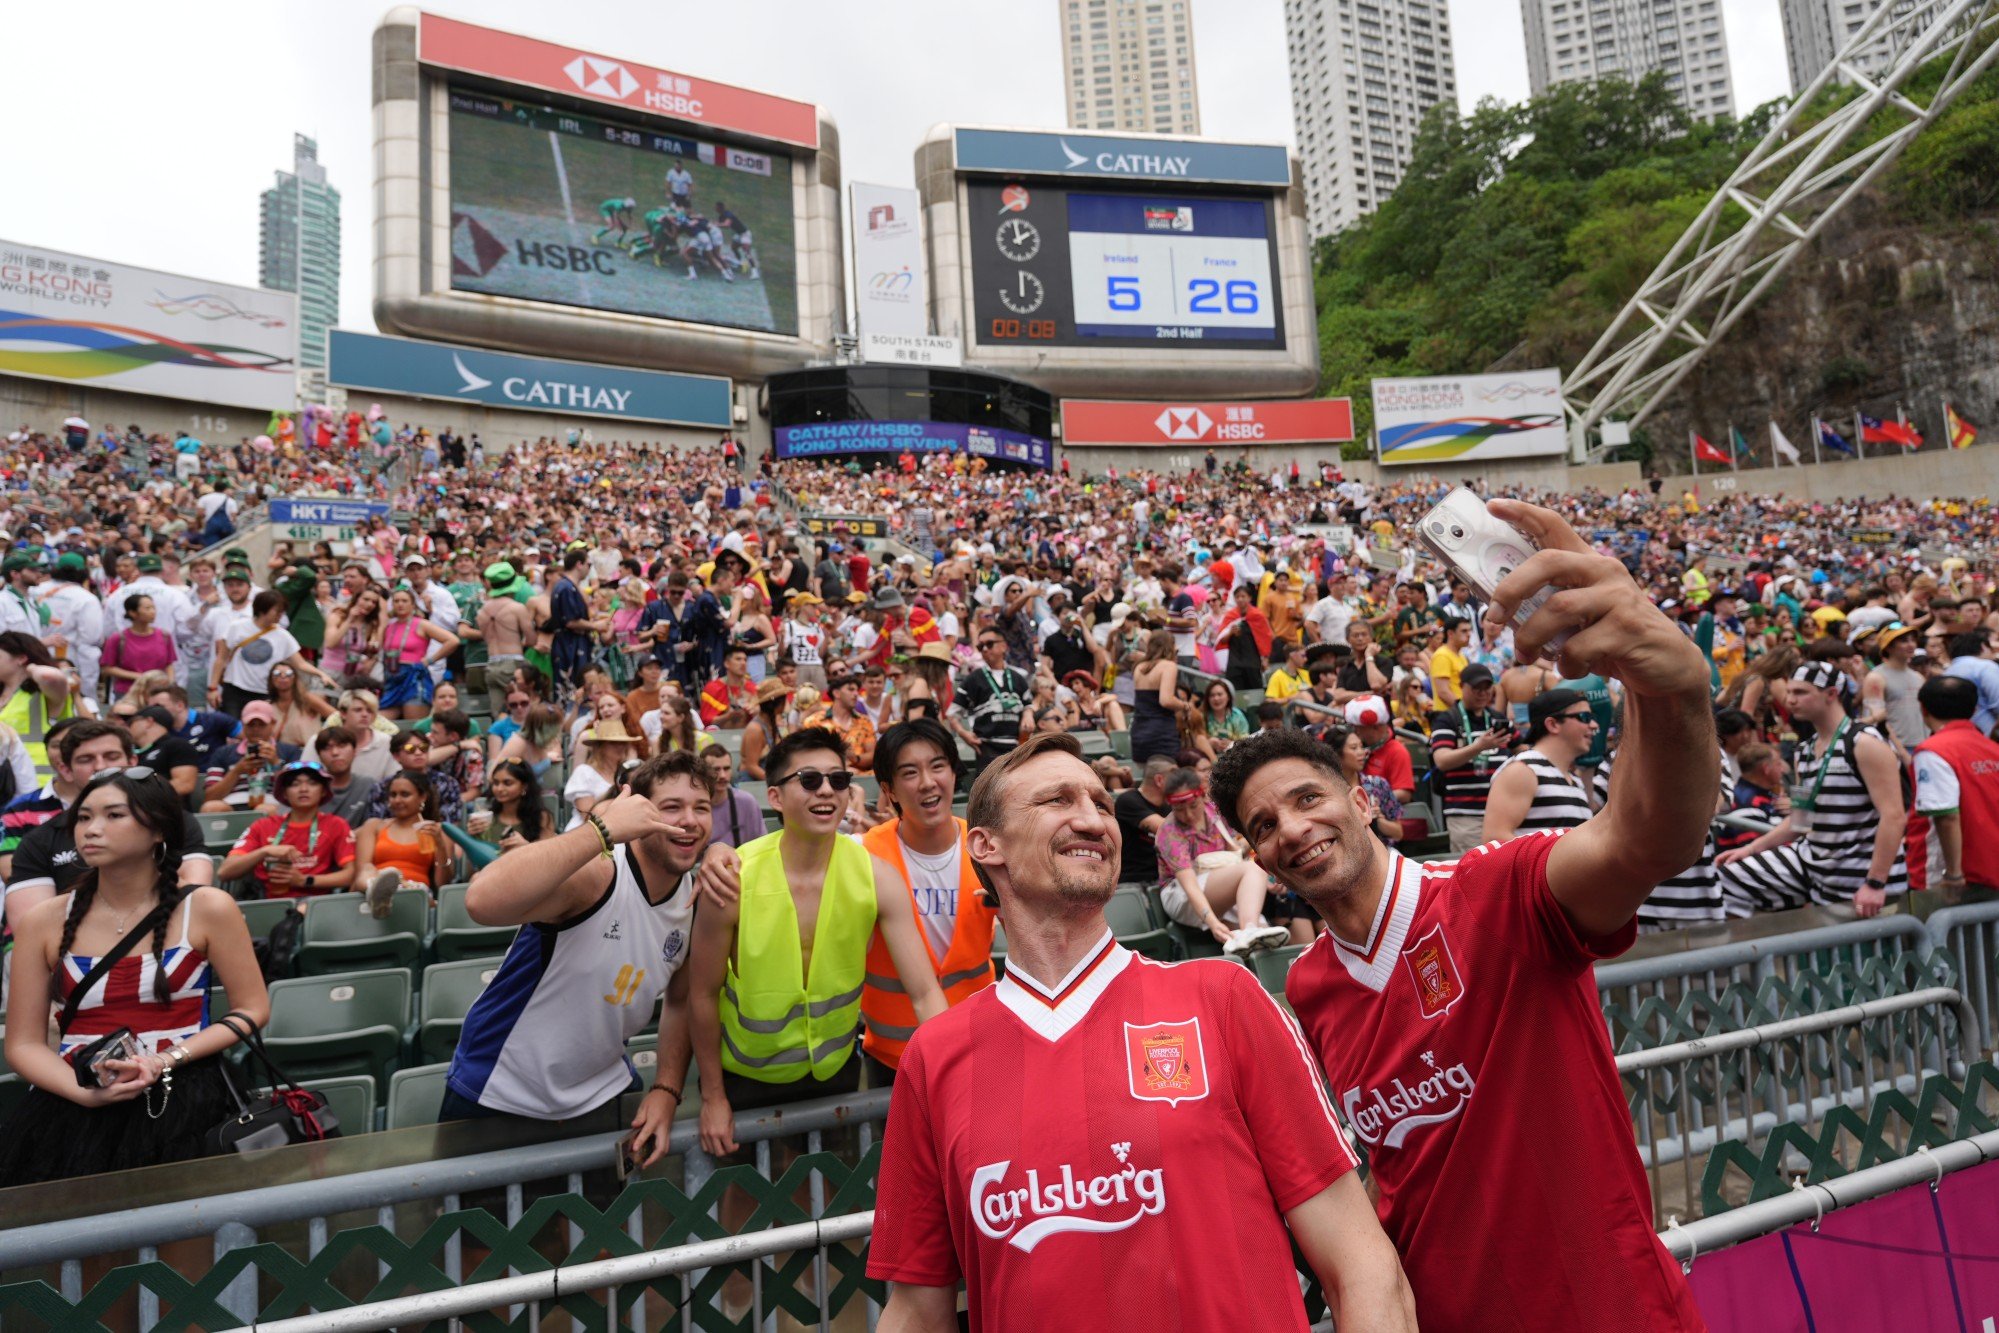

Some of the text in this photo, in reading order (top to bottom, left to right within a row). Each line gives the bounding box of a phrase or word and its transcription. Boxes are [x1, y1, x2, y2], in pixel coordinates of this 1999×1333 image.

[644, 90, 703, 117] HSBC
[558, 117, 583, 134] IRL
[654, 137, 682, 154] FRA
[1095, 152, 1191, 176] CATHAY
[514, 239, 617, 276] HSBC
[1103, 254, 1139, 264] Ireland
[1203, 257, 1237, 267] France
[28, 270, 112, 300] KONG
[1107, 276, 1141, 311] 5
[0, 281, 111, 309] WORLD CITY
[1188, 279, 1259, 314] 26
[992, 319, 1056, 338] 00:08
[1156, 327, 1204, 339] 2nd Half
[872, 335, 953, 349] SOUTH STAND
[502, 377, 632, 411] CATHAY
[191, 414, 228, 432] 115
[1216, 423, 1265, 439] HSBC
[788, 423, 923, 442] CATHAY/HSBC
[788, 439, 837, 454] HONG
[840, 437, 888, 450] KONG
[892, 438, 958, 451] SEVENS
[1169, 456, 1191, 468] 118
[1712, 478, 1736, 490] 120
[291, 504, 331, 519] HKT
[1148, 1047, 1180, 1055] LIVERPOOL
[1343, 1063, 1475, 1144] Carlsberg
[969, 1160, 1166, 1243] Carlsberg
